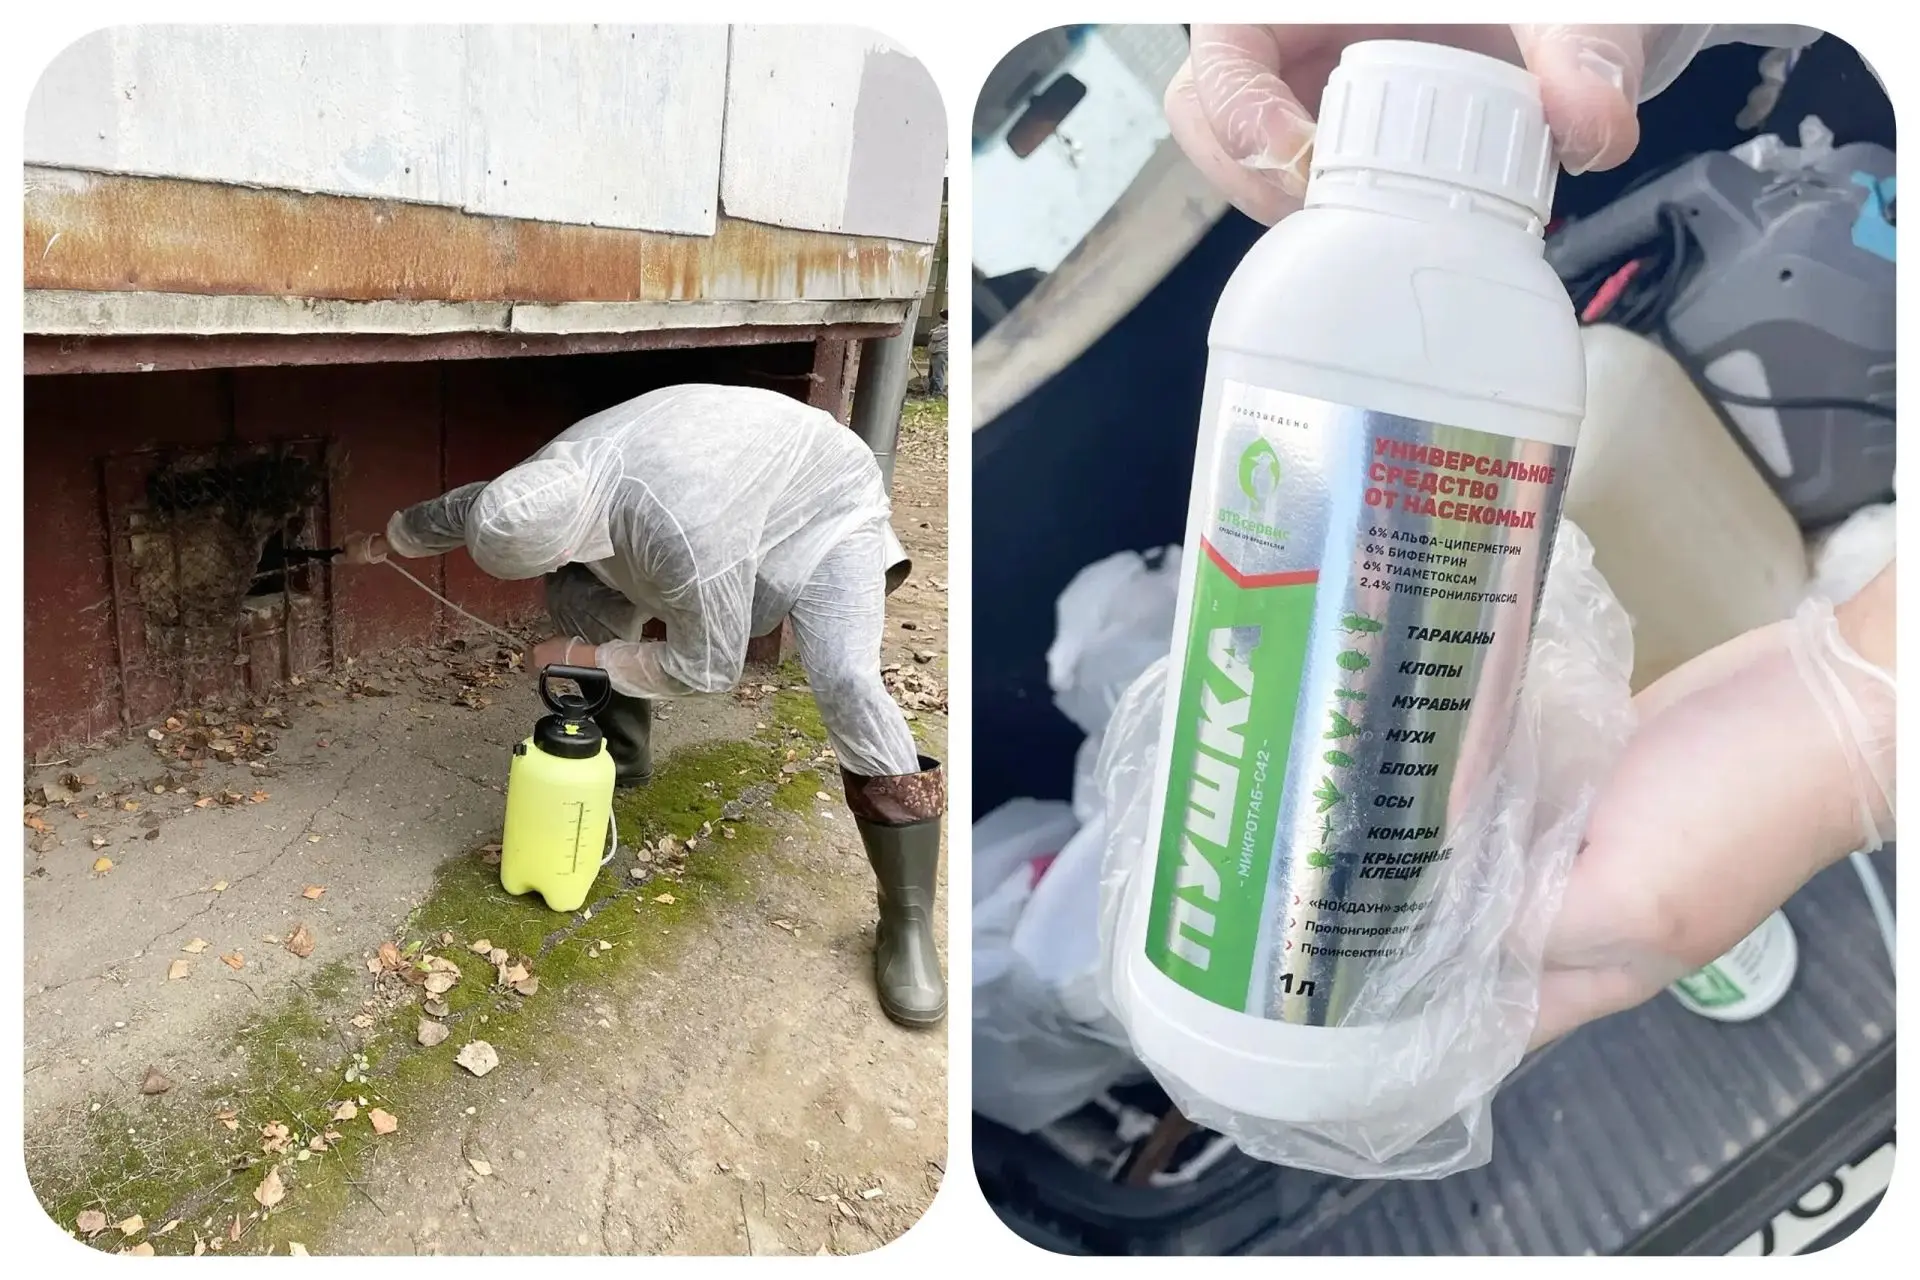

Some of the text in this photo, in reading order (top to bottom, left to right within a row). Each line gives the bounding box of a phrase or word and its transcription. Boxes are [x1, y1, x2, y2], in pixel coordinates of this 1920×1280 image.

[1375, 438, 1556, 485] УНИВЕРСАЛЬНОЕ
[1369, 463, 1499, 500] СРЕДСТВО
[1365, 488, 1536, 529] ОТ НАСЕКОМЫХ
[1369, 526, 1522, 556] 6% АЛЬФА-ЦИПЕРМЕТРИН
[1366, 543, 1468, 568] 6% БИФЕНТРИН
[1363, 560, 1477, 586] 6% ТИАМЕТОКСАМ
[1360, 577, 1518, 604] 2,4% ПИПЕРОНИЛБУТОКСИД
[1407, 626, 1495, 645] ТАРАКАНЫ
[1398, 661, 1463, 678] КЛОПЫ
[1392, 695, 1472, 711] МУРАВЬИ
[1385, 729, 1437, 744] МУХИ
[1379, 762, 1439, 776] БЛОХИ
[1167, 625, 1263, 971] ПУШКА
[1373, 794, 1415, 808] ОСЫ
[1366, 826, 1439, 840] КОМАРЫ
[1362, 848, 1453, 865] КРЫСИНЫЕ
[1359, 866, 1423, 880] КЛЕЩИ
[1309, 898, 1391, 915] «НОКДАУН»
